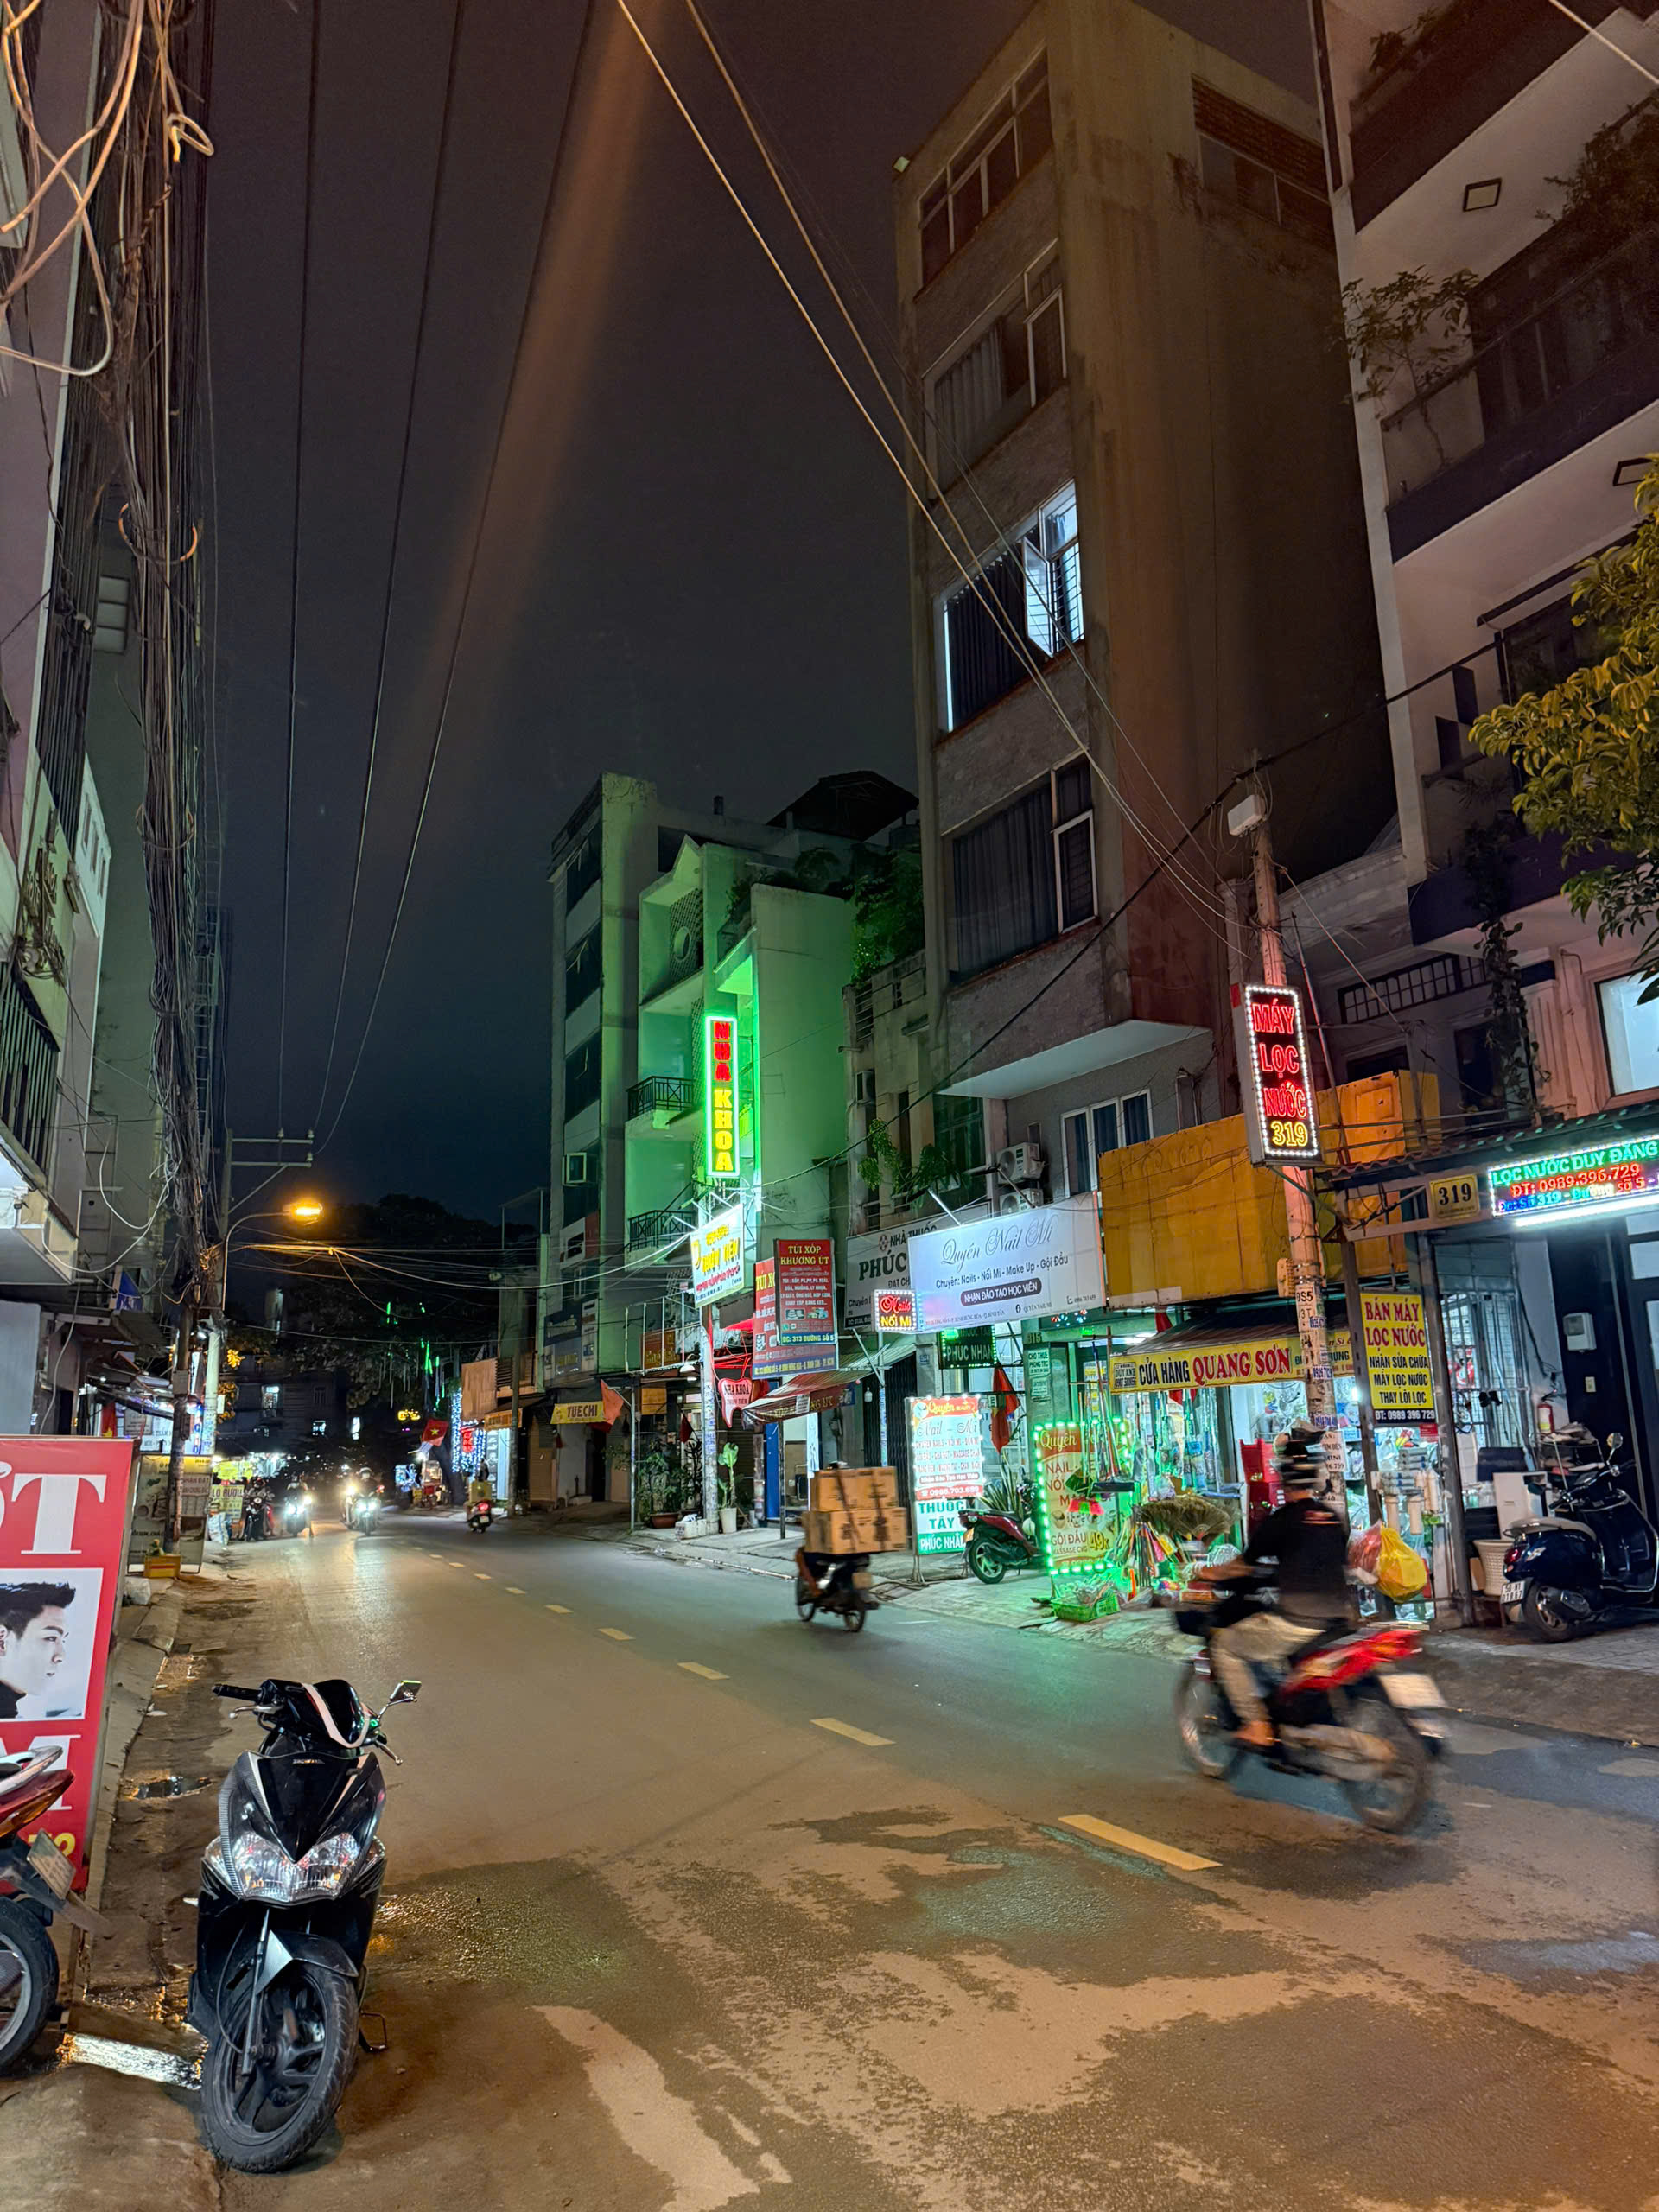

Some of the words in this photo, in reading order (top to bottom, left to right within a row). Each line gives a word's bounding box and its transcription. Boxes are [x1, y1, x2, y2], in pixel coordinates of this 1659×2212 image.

[1252, 998, 1294, 1034] MÁY
[713, 1021, 732, 1081] NHA
[1258, 1043, 1300, 1078] LỌC
[1263, 1081, 1307, 1119] NƯỚC
[714, 1089, 734, 1171] KHOA
[1271, 1121, 1308, 1147] 319
[1492, 1170, 1522, 1189] LỌC
[1525, 1158, 1569, 1179] NƯỚC
[1572, 1151, 1605, 1171] DUY
[1609, 1141, 1658, 1162] ĐĂNG
[1511, 1182, 1536, 1198] ĐT:
[1539, 1163, 1639, 1193] 0989.396.729
[1438, 1182, 1472, 1205] 319
[1537, 1192, 1562, 1205] 319
[788, 1244, 802, 1254] TÚI
[804, 1244, 821, 1254] XỐP
[890, 1230, 906, 1247] NHÀ
[984, 1225, 1025, 1256] Nail
[780, 1256, 816, 1265] KHƯƠNG
[818, 1255, 830, 1265] ÚT
[859, 1249, 906, 1281] PHÚC
[936, 1276, 961, 1289] Chuyên:
[961, 1274, 976, 1285] Nails
[981, 1270, 992, 1282] Nối
[993, 1268, 1001, 1279] Mi
[1006, 1264, 1025, 1276] Make
[1025, 1262, 1035, 1274] Up
[1040, 1258, 1052, 1271] Gội
[1053, 1251, 1068, 1267] Đầu
[880, 1294, 912, 1313] Nails
[964, 1293, 982, 1304] NHẬN
[982, 1288, 994, 1300] ĐÀO
[995, 1289, 1008, 1301] TẠO
[1007, 1286, 1023, 1299] HỌC
[1023, 1281, 1038, 1294] VIÊN
[880, 1313, 898, 1327] Nối
[899, 1315, 912, 1327] Mi
[1364, 1297, 1390, 1321] BÁN
[1393, 1298, 1419, 1322] MÁY
[1365, 1327, 1389, 1351] LỌC
[1391, 1323, 1425, 1347] NƯỚC
[947, 1343, 969, 1361] PHÚC
[1392, 1352, 1408, 1369] SỬA
[1409, 1354, 1428, 1369] CHỮA
[1139, 1357, 1160, 1386] CỬA
[1160, 1358, 1191, 1383] HÀNG
[1192, 1351, 1252, 1386] QUANG
[1255, 1344, 1291, 1376] SƠN
[1374, 1370, 1389, 1386] MÁY
[1393, 1374, 1407, 1389] LỌC
[1408, 1371, 1427, 1386] NƯỚC
[1380, 1392, 1397, 1403] THAY
[1413, 1392, 1427, 1406] LỌC
[1388, 1410, 1406, 1420] 0989
[1407, 1410, 1421, 1419] 396
[1421, 1409, 1435, 1419] 729
[1040, 1430, 1077, 1451] Quyên
[1046, 1462, 1072, 1473] NAIL
[0, 1461, 107, 1554] T
[929, 1516, 955, 1529] TÂY
[920, 1534, 942, 1550] PHÚC
[1051, 1533, 1067, 1546] GỘI
